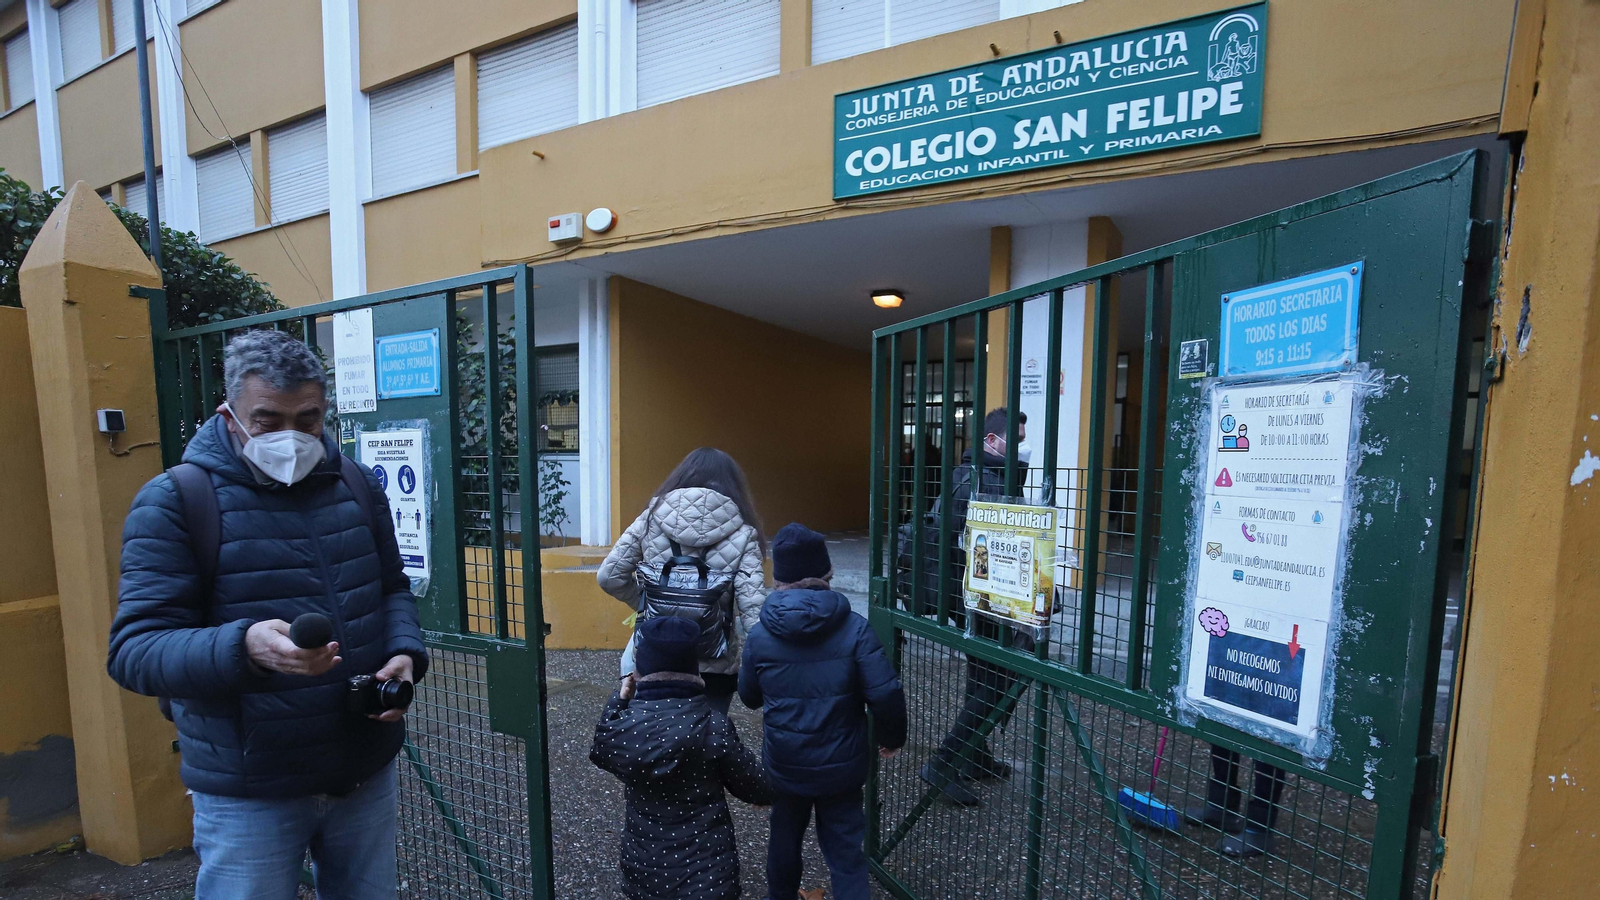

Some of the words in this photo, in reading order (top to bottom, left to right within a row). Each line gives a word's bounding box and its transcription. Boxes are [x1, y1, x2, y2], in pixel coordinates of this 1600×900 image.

[845, 83, 936, 118] JUNTA
[948, 72, 984, 96] DE
[1001, 31, 1189, 84] ANDALUCIA
[845, 103, 939, 131] CONSEJERIA
[945, 96, 968, 111] DE
[975, 77, 1084, 106] EDUCACION
[1087, 72, 1101, 83] Y
[1109, 55, 1189, 79] CIENCIA
[845, 126, 996, 176] COLEGIO
[1013, 109, 1088, 149] SAN
[1106, 81, 1244, 134] FELIPE
[859, 165, 968, 190] EDUCACION
[978, 149, 1069, 171] INFANTIL
[1079, 144, 1095, 155] Y
[1104, 124, 1222, 151] PRIMARIA
[1234, 299, 1277, 323] HORARIO
[1280, 284, 1342, 314] SECRETARIA
[1245, 324, 1276, 344] TODOS
[1279, 319, 1298, 337] LOS
[1302, 314, 1327, 335] DIAS
[385, 340, 428, 356] ENTRADA-SALIDA
[1255, 348, 1275, 367] 9:15
[1277, 351, 1283, 364] a
[1287, 342, 1312, 361] 11:15
[338, 355, 371, 366] PROHIBIDO
[383, 359, 406, 372] ALUMNOS
[407, 356, 433, 369] PRIMARIA
[344, 371, 365, 380] FUMAR
[415, 373, 419, 384] Y
[342, 387, 351, 395] EN
[353, 385, 369, 394] TODO
[339, 401, 346, 409] EL
[349, 399, 374, 410] RECINTO
[1244, 396, 1267, 409] HORARIO
[1268, 395, 1275, 408] DE
[1276, 391, 1310, 407] SECRETARÍA
[1268, 415, 1275, 427] DE
[1276, 414, 1293, 427] LUNES
[1294, 416, 1299, 426] A
[1300, 413, 1324, 426] VIERNES
[1261, 434, 1268, 446] DE
[1268, 434, 1285, 446] 10:00
[1287, 435, 1291, 446] A
[1292, 434, 1309, 446] 11:00
[1309, 433, 1329, 446] HORAS
[1242, 472, 1269, 483] NECESARIO
[1270, 473, 1299, 484] SOLICITAR
[1299, 474, 1313, 485] CITA
[1314, 475, 1335, 486] PREVIA
[967, 507, 999, 524] otería
[999, 508, 1053, 530] Navidad
[1239, 506, 1258, 518] FORMAS
[1259, 508, 1266, 519] DE
[1267, 509, 1296, 522] CONTACTO
[1256, 532, 1265, 544] 956
[1266, 533, 1273, 544] 67
[1273, 534, 1280, 546] 01
[1281, 535, 1288, 547] 88
[1245, 574, 1291, 592] CEIPSANFELIPE.ES
[1244, 617, 1270, 633] ¡GRACIAS!
[1226, 648, 1238, 662] NO
[1239, 651, 1281, 674] RECOGEMOS
[1208, 665, 1218, 679] NI
[1219, 667, 1263, 693] ENTREGAMOS
[1264, 680, 1298, 703] OLVIDOS
